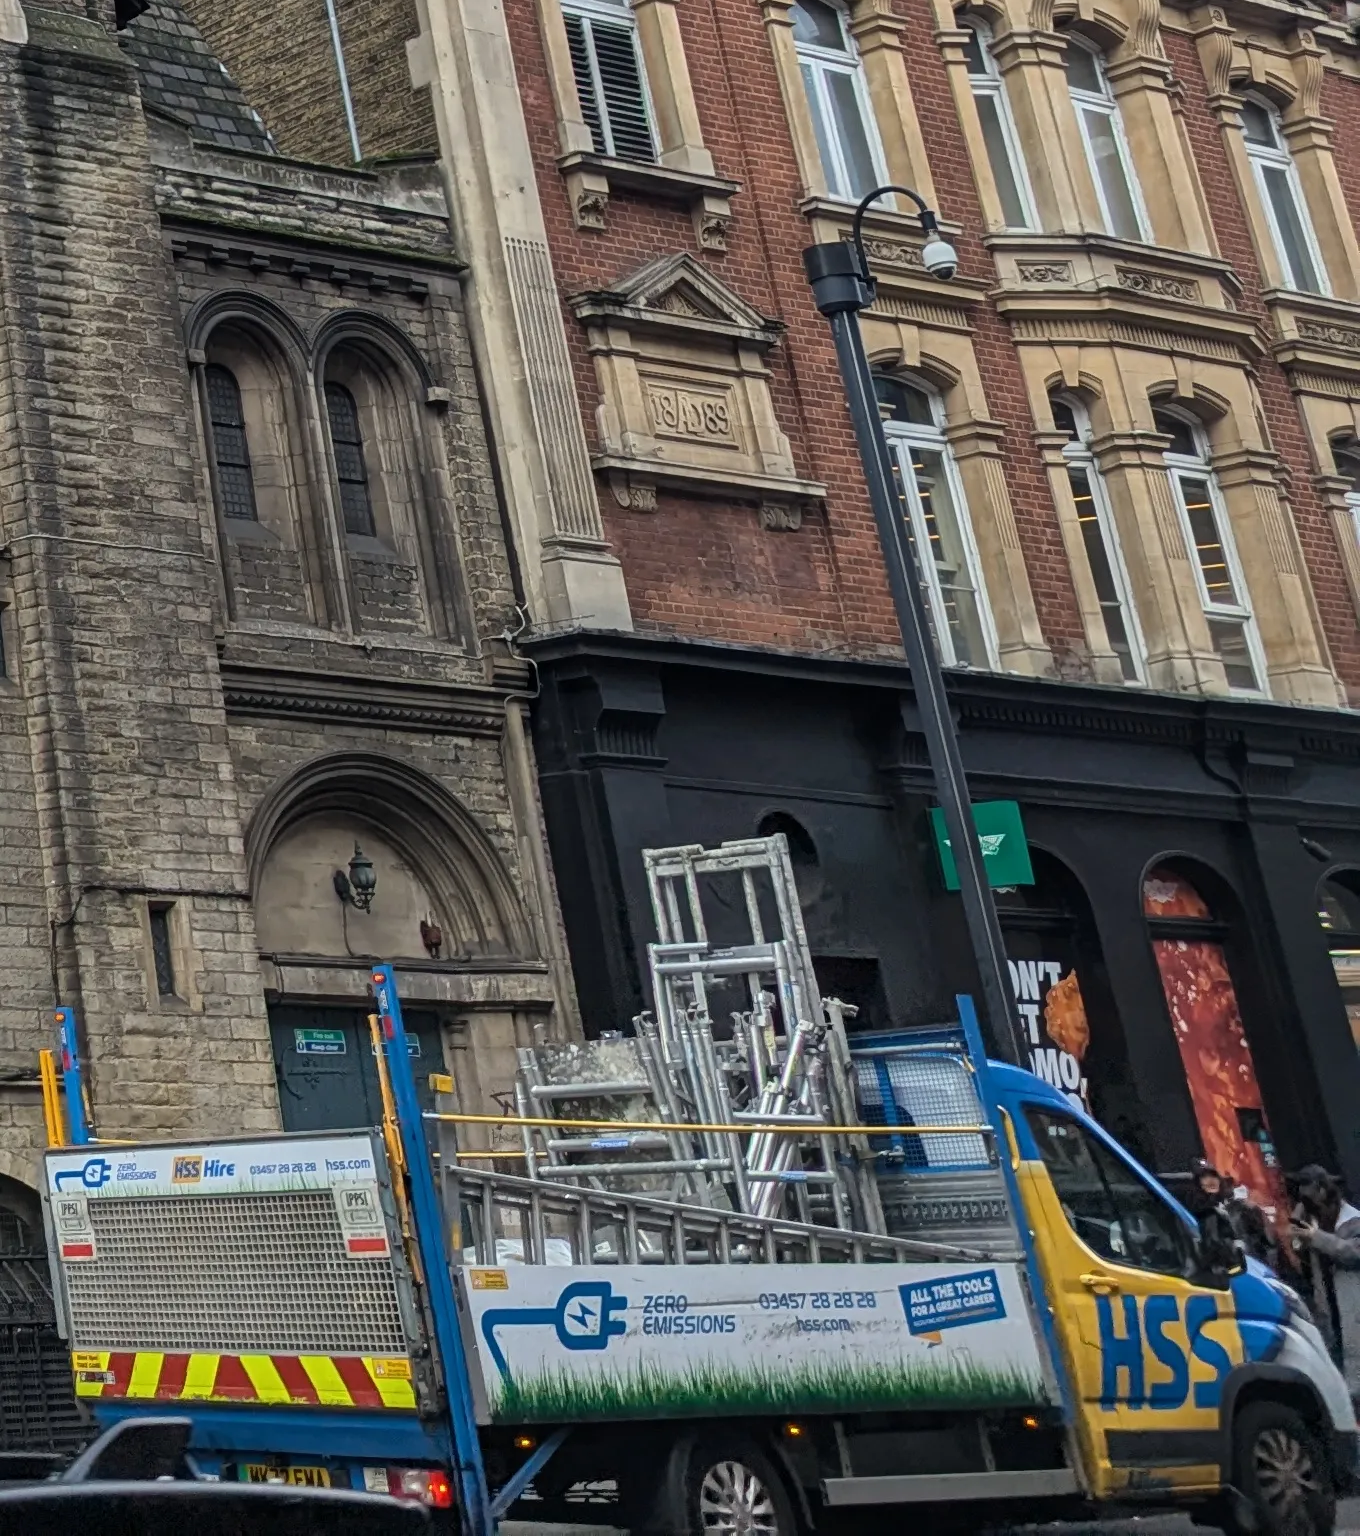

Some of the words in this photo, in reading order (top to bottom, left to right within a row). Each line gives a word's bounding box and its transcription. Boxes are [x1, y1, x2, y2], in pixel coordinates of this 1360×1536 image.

[1007, 960, 1062, 1000] N'T
[117, 1163, 137, 1172] ZERO
[174, 1160, 200, 1178] HSS
[204, 1159, 235, 1177] Hire
[249, 1164, 277, 1175] 03457
[278, 1163, 290, 1173] 28
[291, 1163, 303, 1173] 28
[304, 1162, 317, 1172] 28
[325, 1158, 371, 1171] hss.com
[116, 1171, 157, 1181] EMISSIONS
[910, 1288, 932, 1304] ALL
[931, 1283, 955, 1300] THE
[954, 1276, 992, 1295] TOOLS
[643, 1295, 688, 1314] ZERO
[758, 1292, 807, 1309] 03457
[811, 1292, 830, 1309] 28
[833, 1292, 853, 1308] 28
[856, 1291, 876, 1308] 28
[911, 1305, 928, 1317] FOR
[928, 1304, 936, 1314] A
[936, 1298, 961, 1313] GREAT
[962, 1292, 995, 1307] CAREER
[642, 1314, 736, 1335] EMISSIONS
[796, 1315, 851, 1332] hss.com
[1096, 1294, 1231, 1411] HSS
